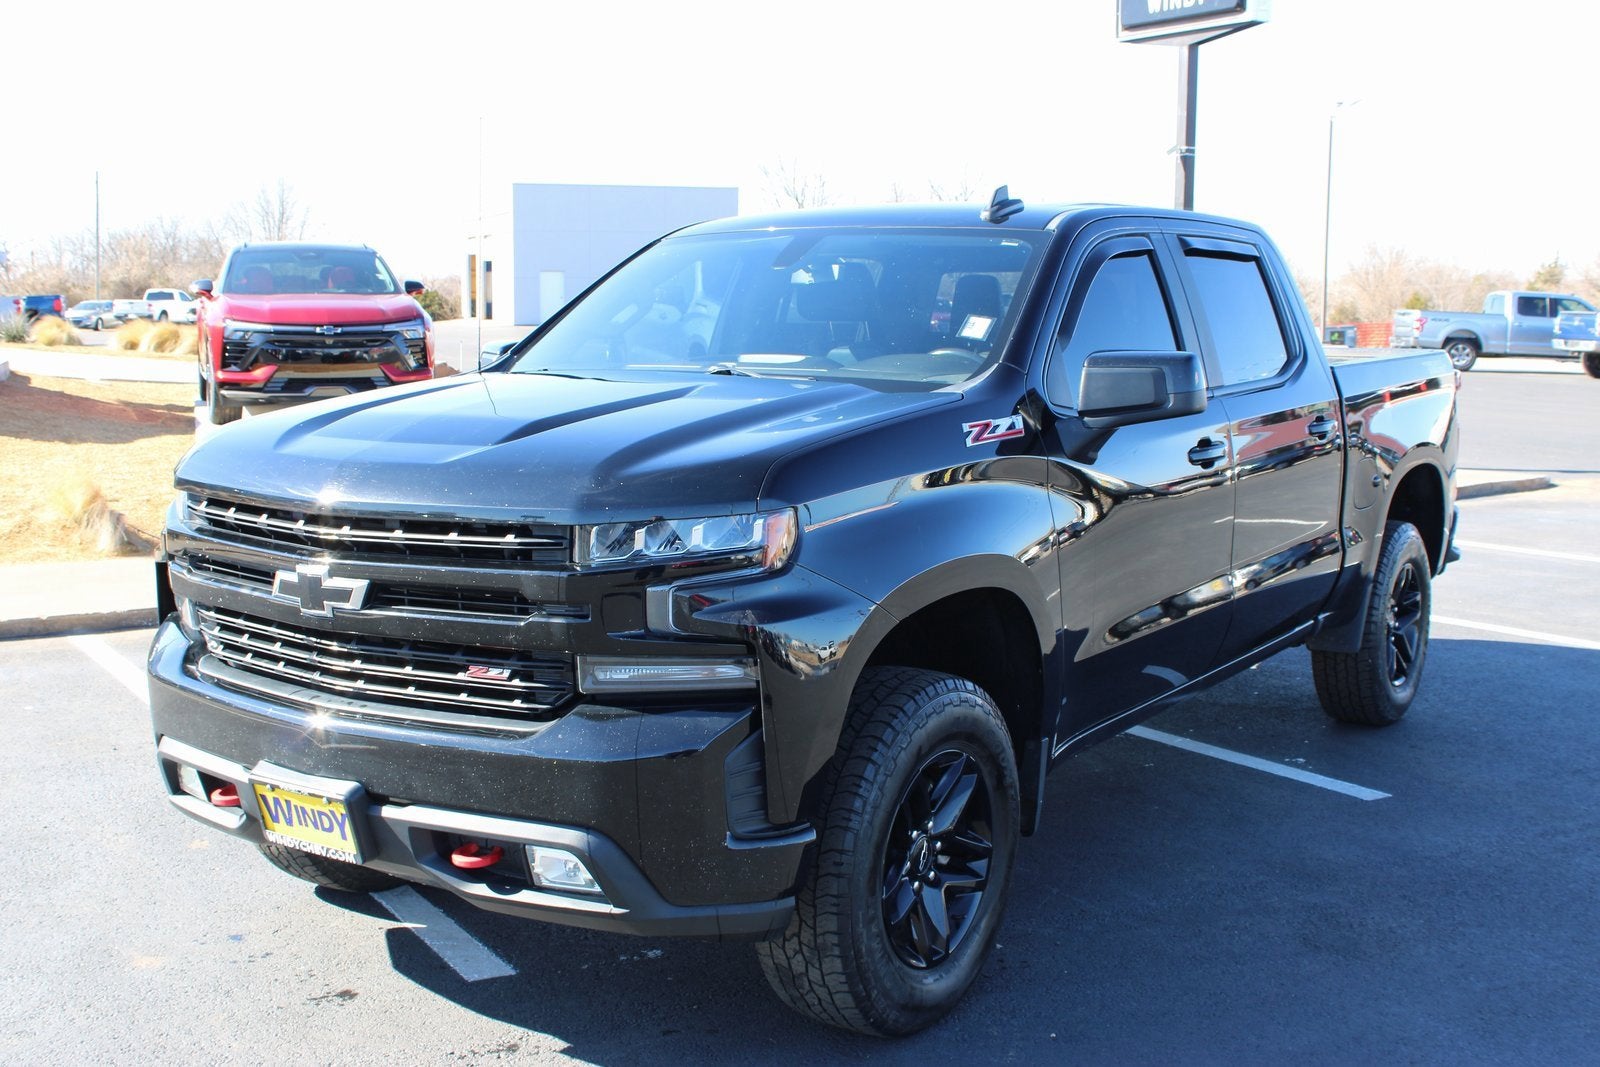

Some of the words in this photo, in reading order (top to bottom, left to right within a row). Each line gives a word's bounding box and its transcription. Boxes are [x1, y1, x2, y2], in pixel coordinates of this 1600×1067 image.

[962, 414, 1024, 447] Z71
[466, 665, 511, 681] Z71
[260, 794, 348, 840] WINDY
